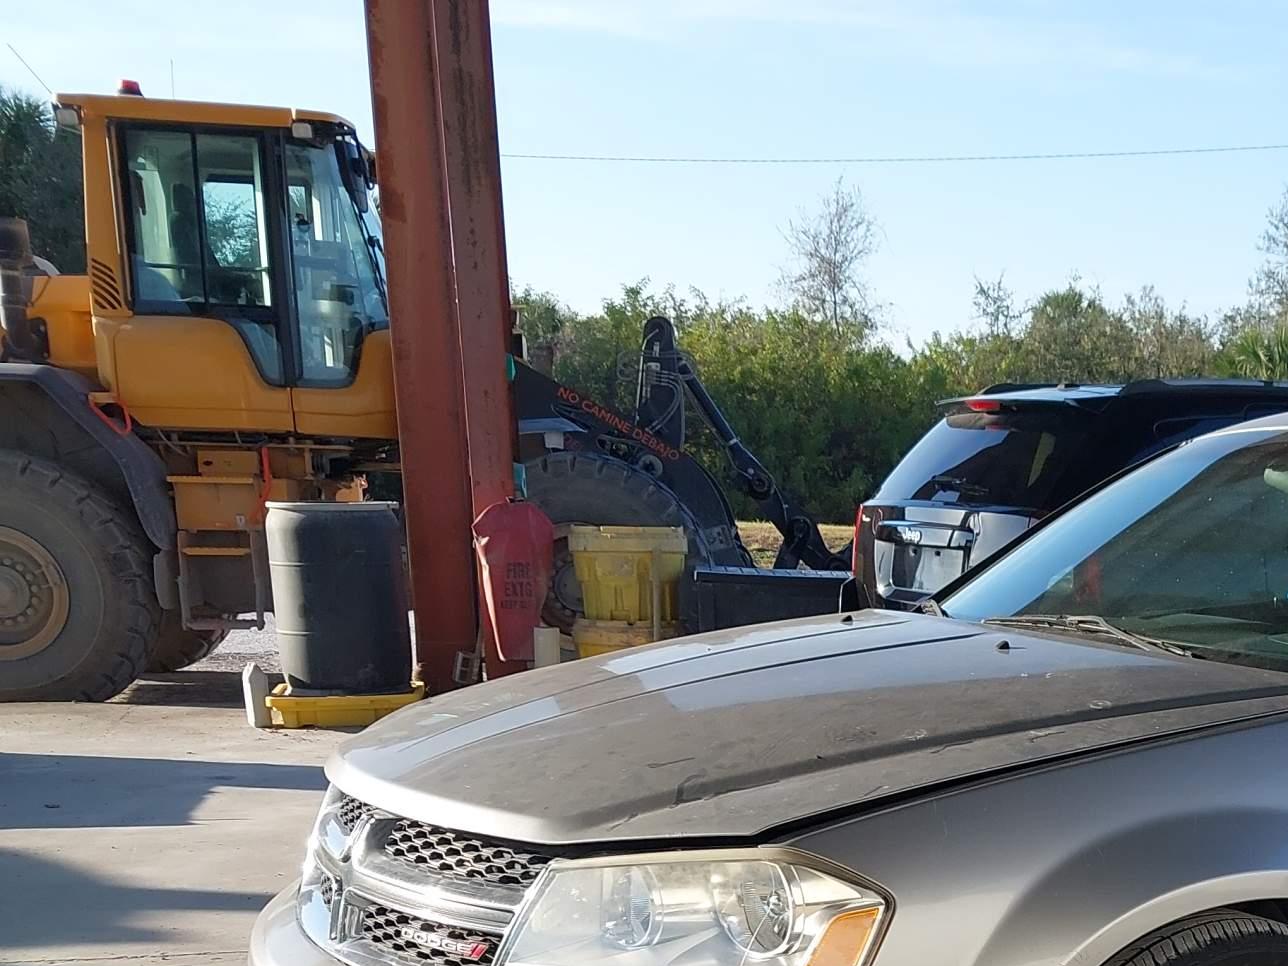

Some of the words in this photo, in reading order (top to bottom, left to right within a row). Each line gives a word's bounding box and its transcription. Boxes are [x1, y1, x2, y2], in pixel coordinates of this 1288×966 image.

[558, 386, 580, 404] NO
[582, 401, 632, 433] CAMINE
[632, 427, 680, 461] DEBAJO
[902, 526, 921, 543] Jeep
[401, 926, 473, 955] DODGE
